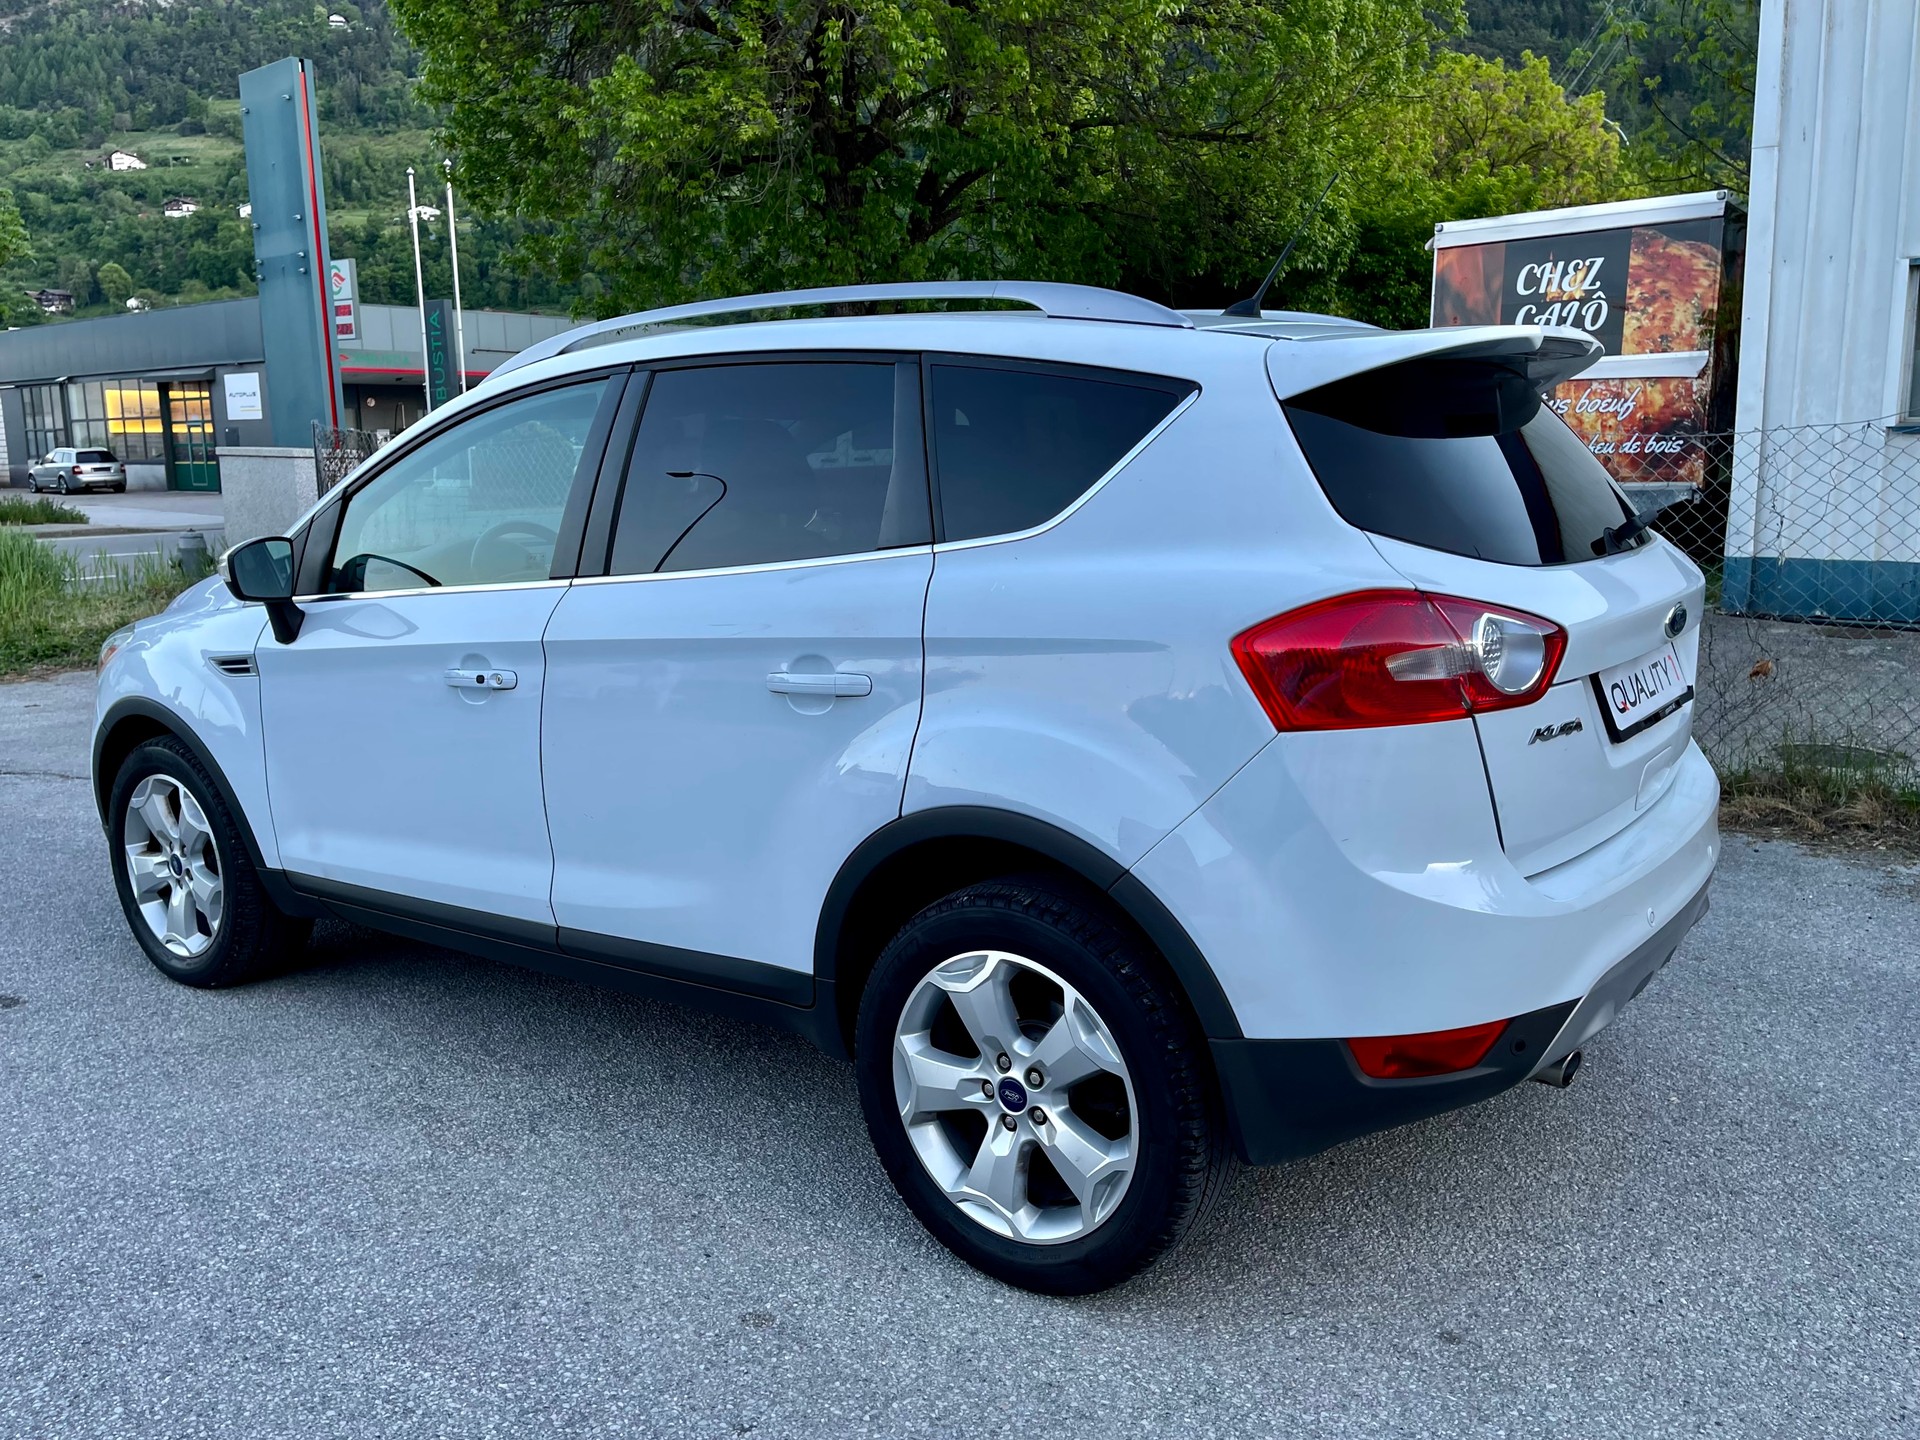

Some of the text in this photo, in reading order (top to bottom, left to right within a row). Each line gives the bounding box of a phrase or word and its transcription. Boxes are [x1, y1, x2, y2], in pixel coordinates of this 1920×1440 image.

[1516, 257, 1605, 295] CHEZ
[430, 309, 447, 404] BUSTIA
[1619, 433, 1641, 454] de
[1644, 432, 1684, 454] bois
